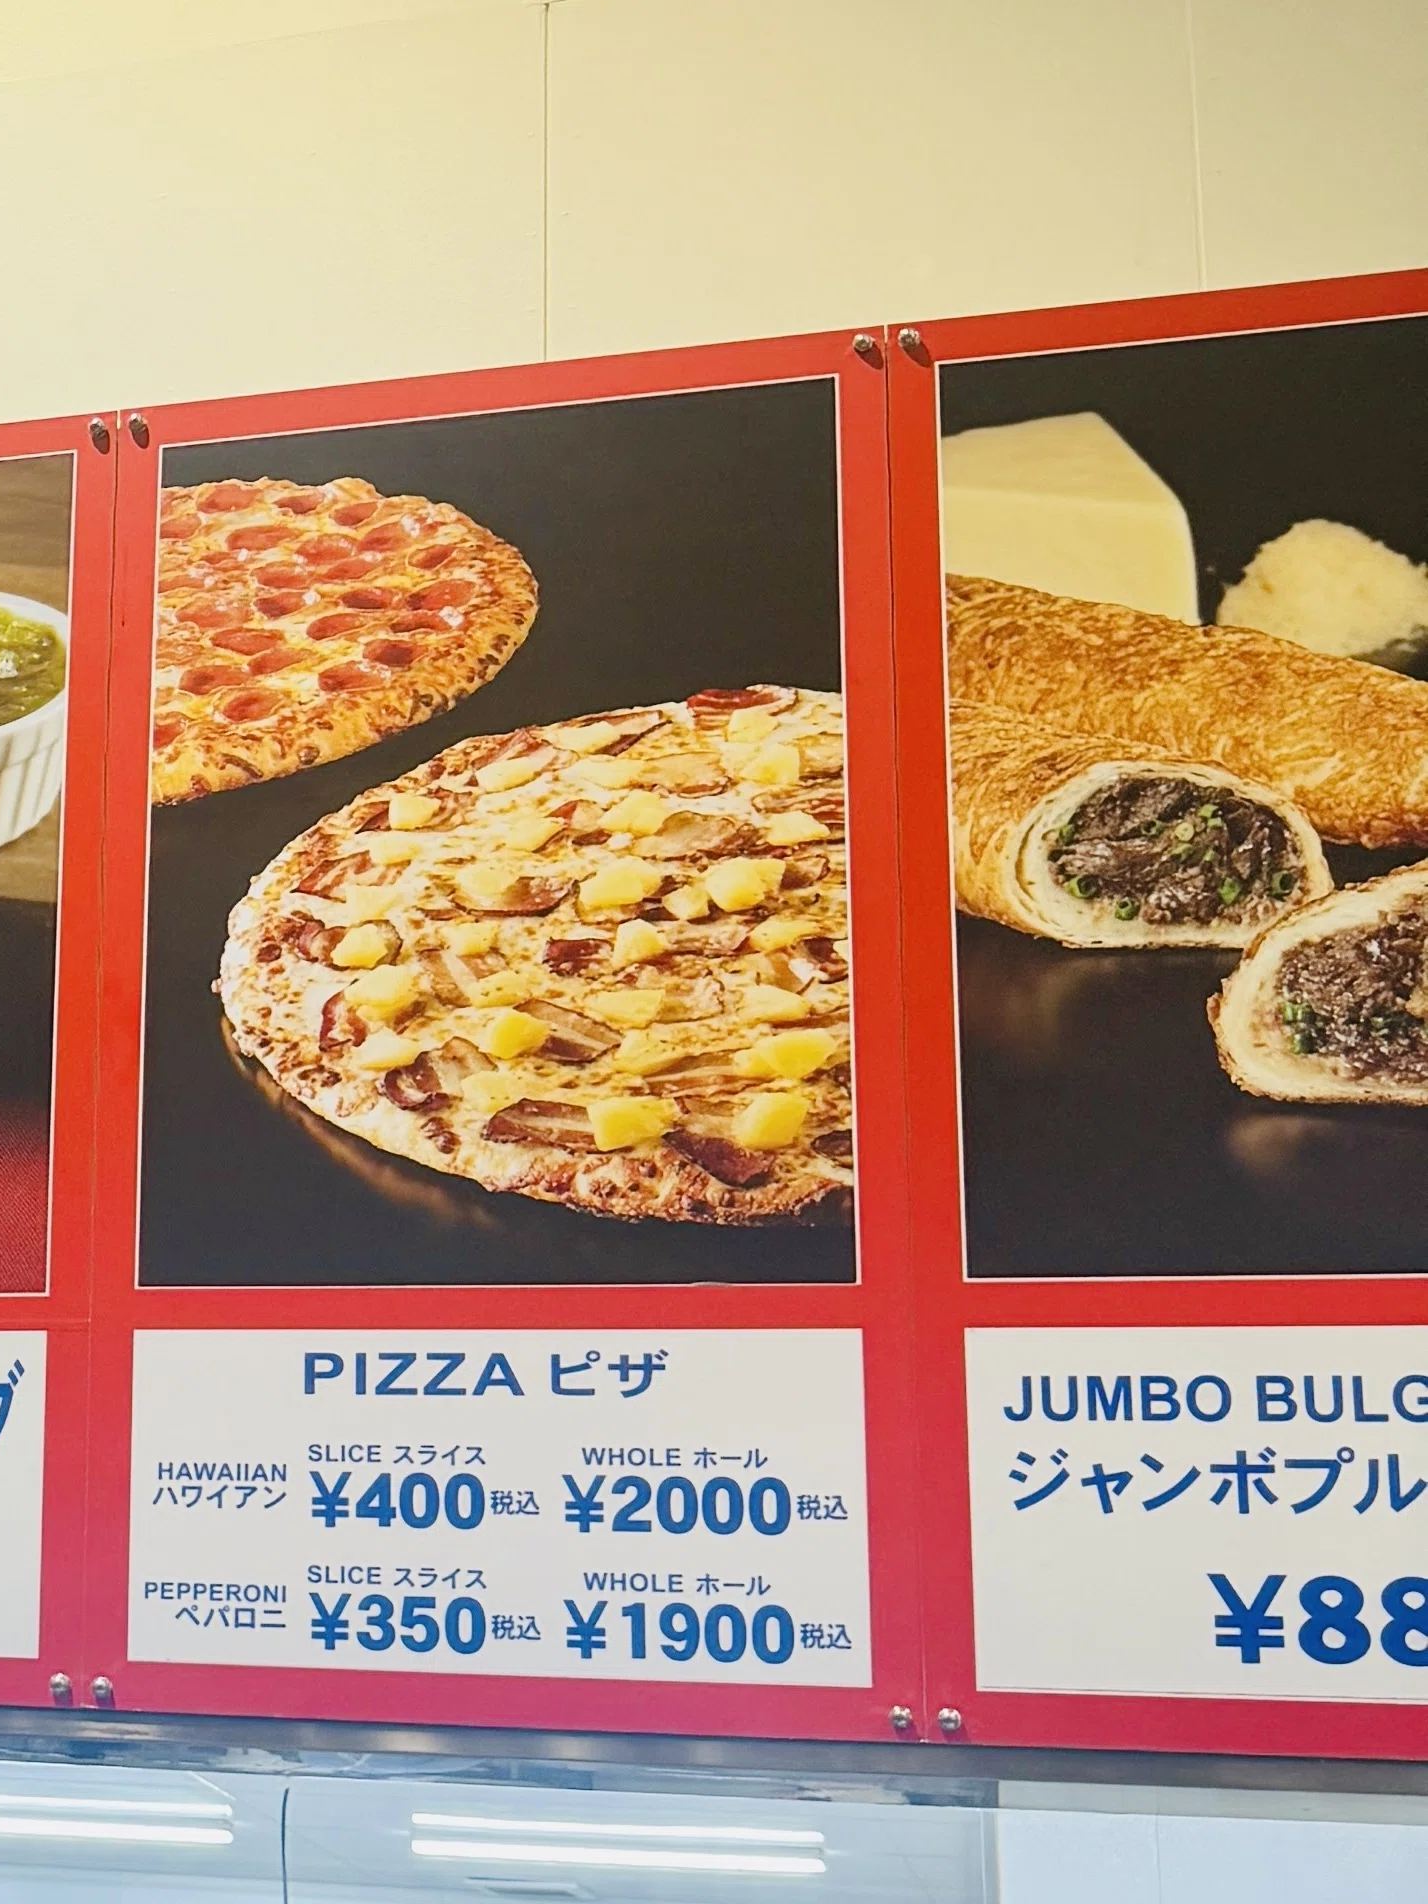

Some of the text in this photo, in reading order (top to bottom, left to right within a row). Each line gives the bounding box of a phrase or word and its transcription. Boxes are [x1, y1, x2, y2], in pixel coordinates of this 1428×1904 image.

[305, 1350, 668, 1398] PIZZA ピザ
[1004, 1375, 1231, 1422] JUMBO
[309, 1444, 485, 1465] SLICE スライス
[582, 1448, 767, 1468] WHOLE ホール
[159, 1463, 286, 1483] HAWAIIAN
[1009, 1447, 1428, 1514] ジャンボプル
[153, 1485, 286, 1508] ハワイアン
[310, 1471, 539, 1529] ¥400 税込
[563, 1475, 848, 1535] ¥2000 税込
[145, 1582, 286, 1603] PEPPERONI
[308, 1565, 486, 1589] SLICE スライス
[584, 1573, 771, 1595] WHOLE ホール
[175, 1605, 286, 1628] ペパロニ
[309, 1593, 540, 1654] ¥350 税込
[564, 1600, 851, 1664] ¥1900 税込
[1208, 1574, 1428, 1667] ¥88
